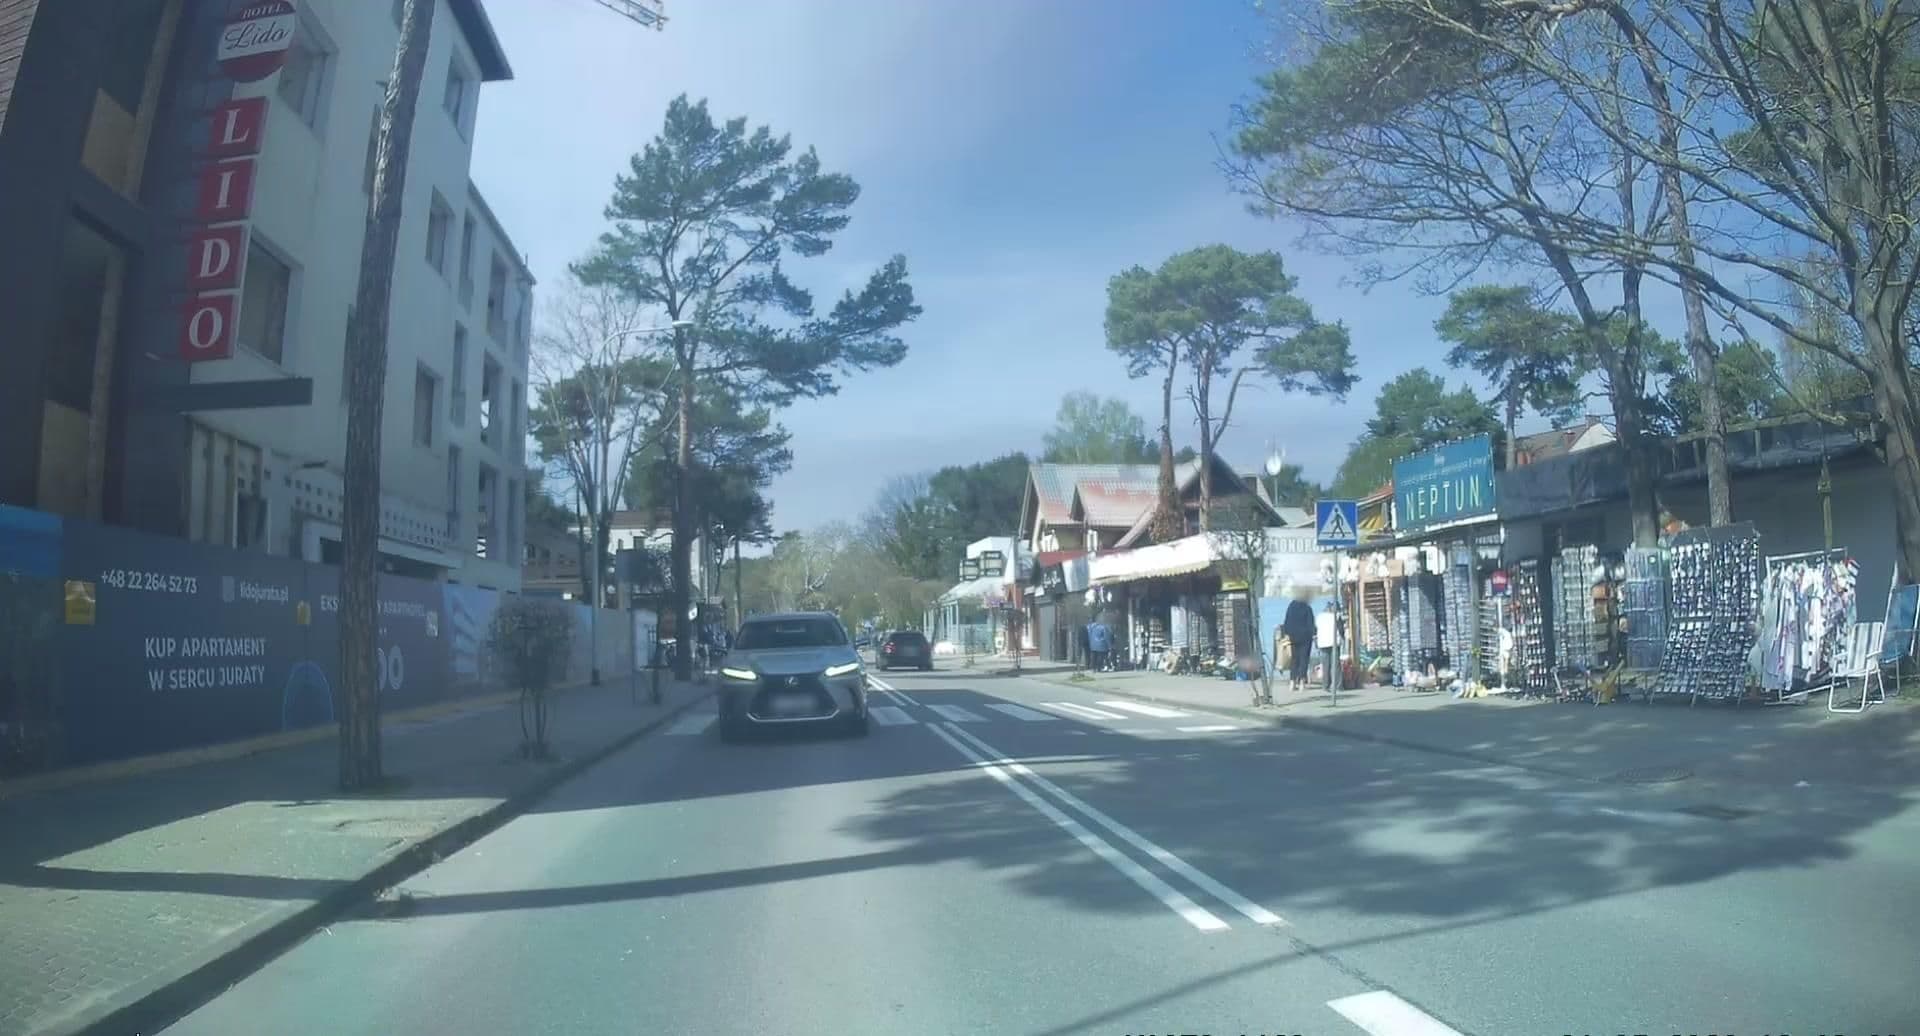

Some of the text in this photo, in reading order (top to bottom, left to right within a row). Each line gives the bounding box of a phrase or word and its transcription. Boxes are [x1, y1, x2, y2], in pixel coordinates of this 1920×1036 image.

[225, 21, 289, 50] Lido
[189, 108, 249, 349] LIDO
[1405, 473, 1480, 521] NEPTUN
[101, 569, 198, 595] +48 22 264 52 73
[145, 637, 267, 658] KUP APARTAMENT
[148, 665, 265, 691] W SERCU JURATY
